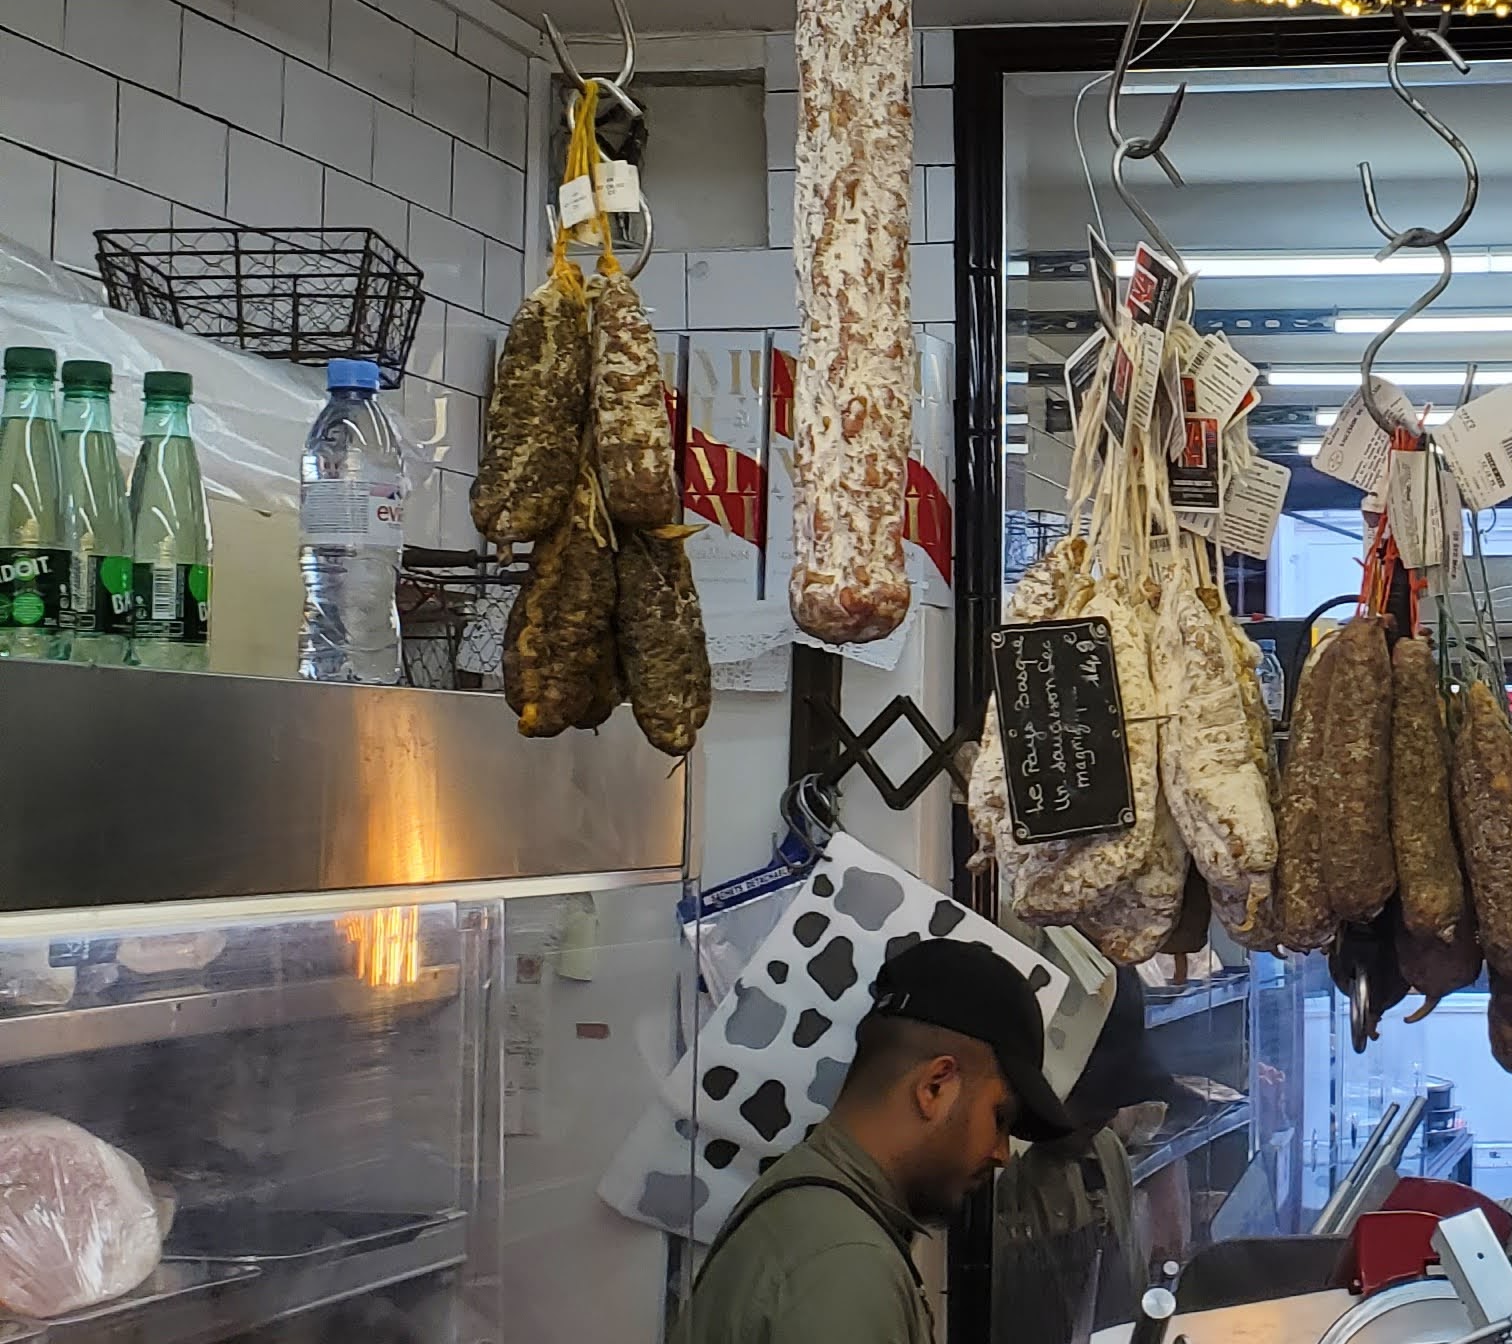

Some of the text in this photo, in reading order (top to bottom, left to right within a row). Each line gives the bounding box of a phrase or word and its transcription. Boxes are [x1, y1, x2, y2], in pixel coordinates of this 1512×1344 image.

[0, 556, 49, 583] DOIT
[1012, 635, 1048, 813] Le Pays Basque
